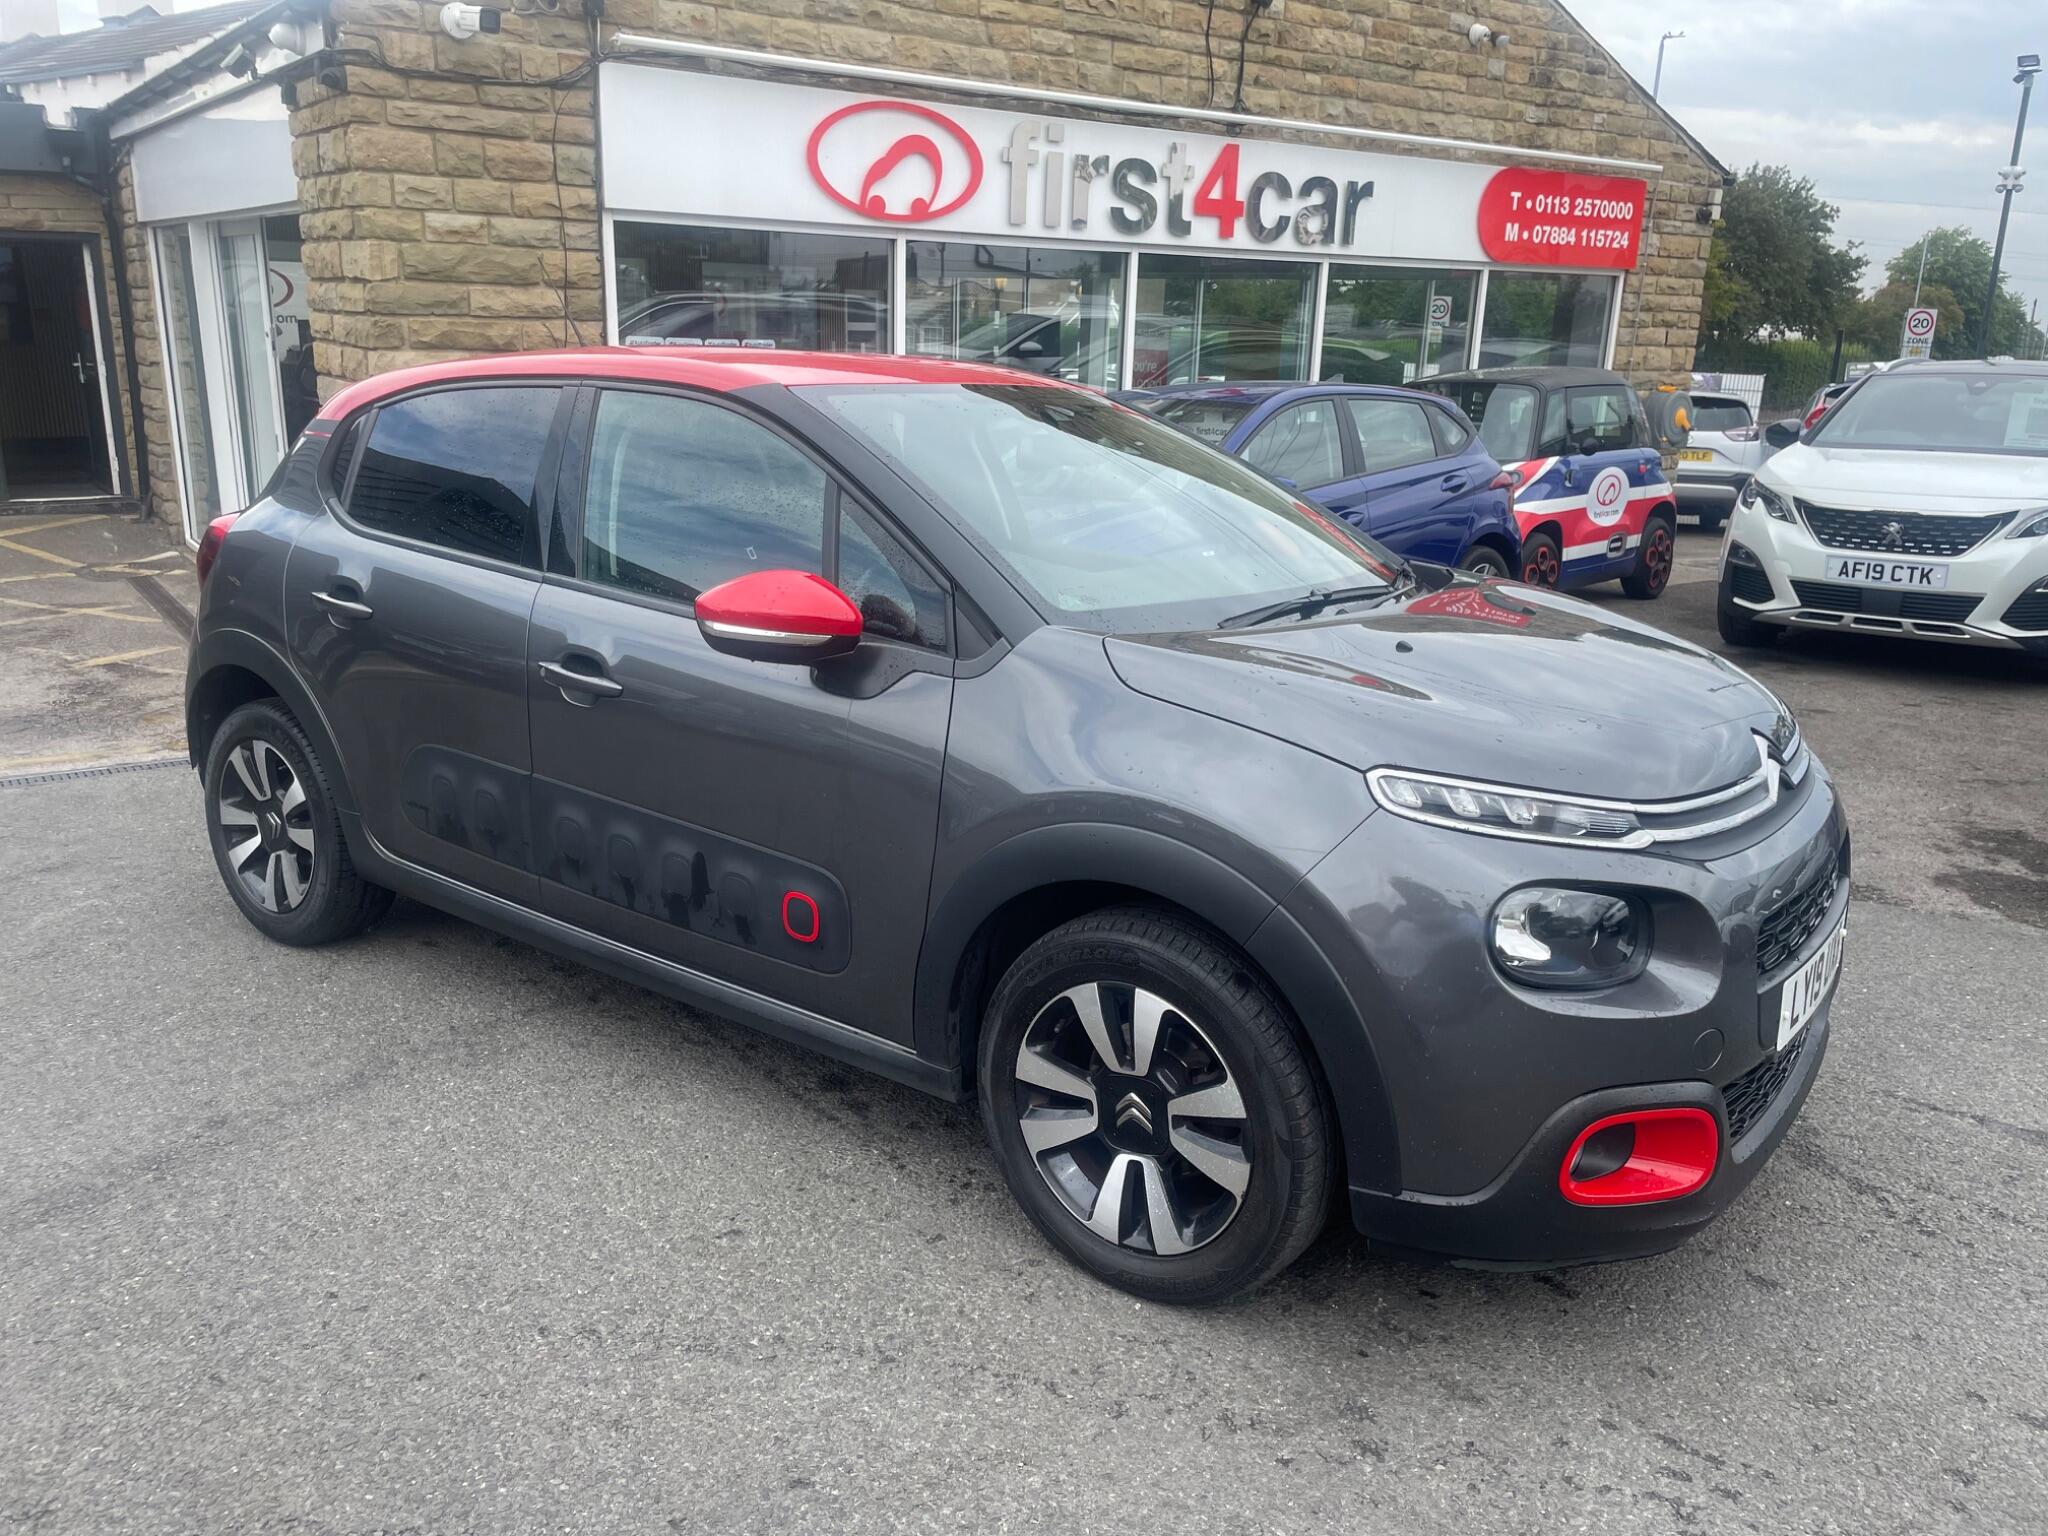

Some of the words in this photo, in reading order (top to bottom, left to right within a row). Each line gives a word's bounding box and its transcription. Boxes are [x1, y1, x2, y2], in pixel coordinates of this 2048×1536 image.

[1002, 119, 1375, 247] first4car
[1535, 194, 1570, 215] 0113
[1573, 198, 1634, 220] 2570000
[1532, 225, 1576, 246] 07884
[1580, 229, 1630, 249] 115724
[1431, 304, 1446, 314] 20
[1912, 318, 1930, 329] 20
[1907, 337, 1929, 345] ZONE
[1838, 560, 1885, 580] AF19
[1890, 565, 1934, 585] CTK
